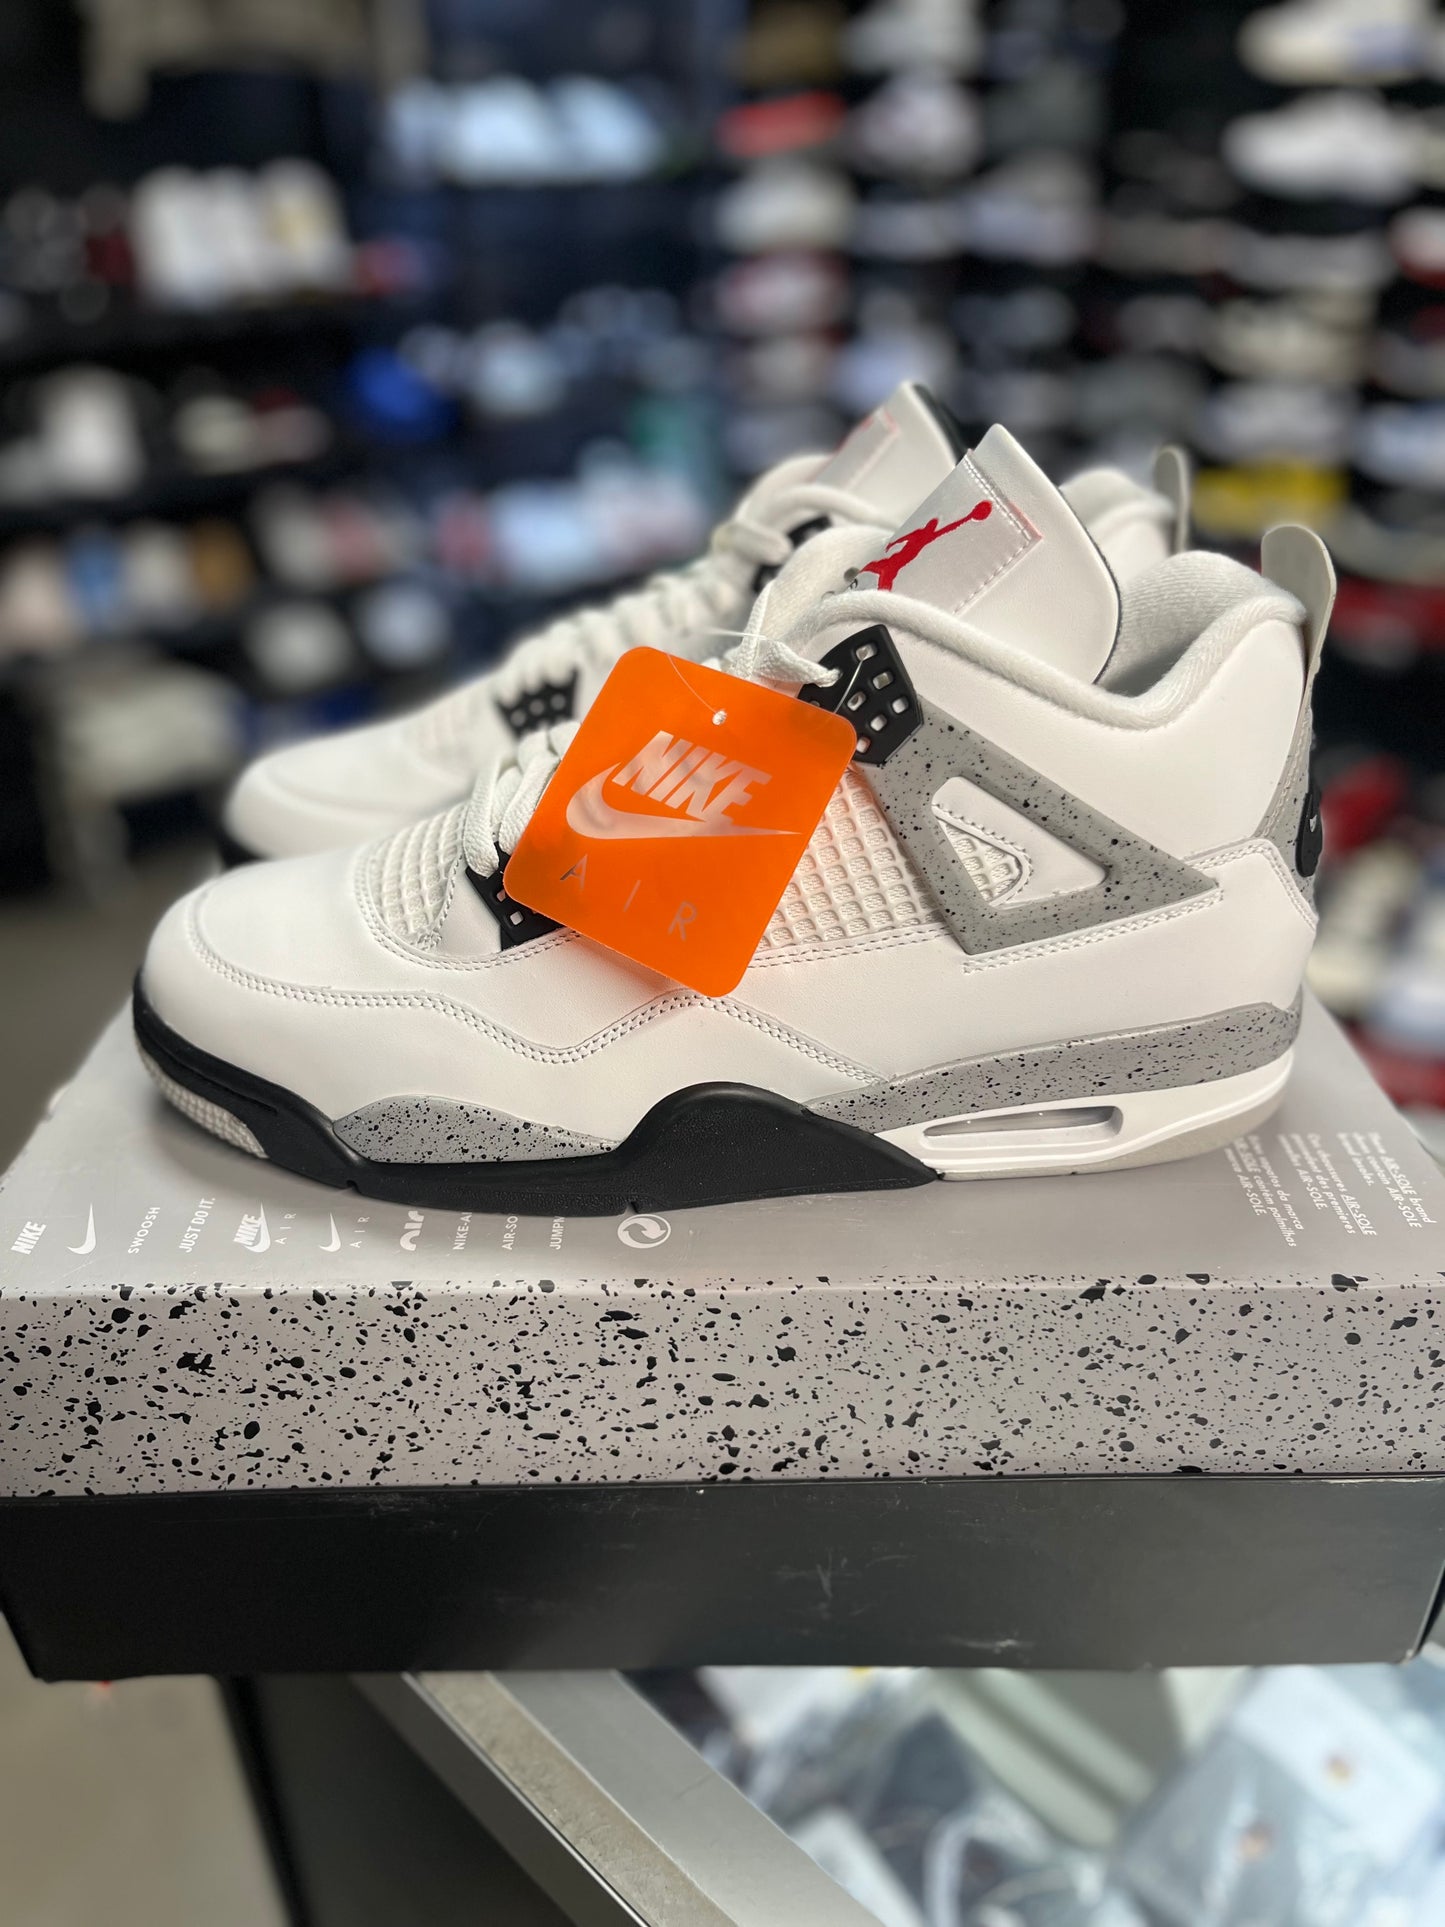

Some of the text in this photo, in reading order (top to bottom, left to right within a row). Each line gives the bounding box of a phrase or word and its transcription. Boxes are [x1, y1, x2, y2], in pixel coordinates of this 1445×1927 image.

[612, 730, 773, 827] NIKE
[559, 854, 698, 942] AIR
[1277, 1190, 1291, 1201] da
[1315, 1175, 1330, 1189] des
[1379, 1155, 1417, 1195] AIR-SOLE
[1409, 1197, 1437, 1223] brand
[179, 1198, 216, 1253] JUST DO IT.
[1267, 1206, 1297, 1247] palmilhas
[1283, 1203, 1304, 1230] marca
[1340, 1194, 1377, 1236] AIR-SOLE
[1386, 1187, 1422, 1228] AIR-SOLE
[11, 1221, 47, 1255] NIKE
[127, 1206, 161, 1254] SWOOSH
[233, 1213, 261, 1246] NIKE
[275, 1213, 297, 1245] AIR
[349, 1216, 370, 1249] AIR
[502, 1214, 519, 1250] AIR-SO
